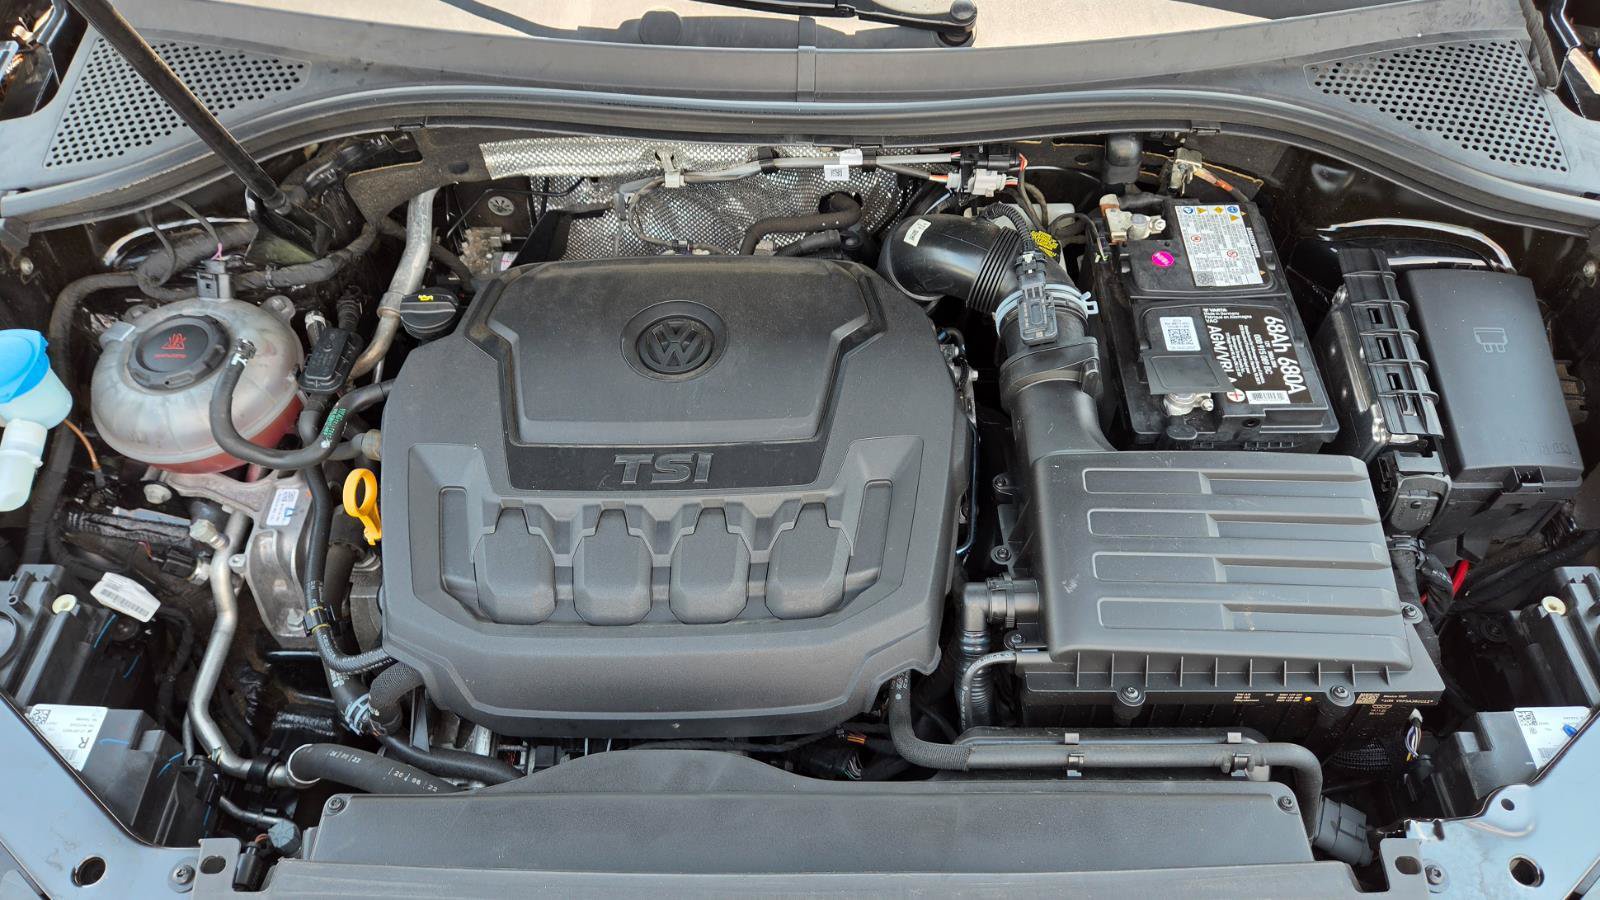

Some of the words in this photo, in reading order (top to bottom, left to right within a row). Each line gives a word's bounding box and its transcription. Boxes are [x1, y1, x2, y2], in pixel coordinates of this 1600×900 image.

[1263, 316, 1292, 353] 68Ah
[1277, 356, 1307, 394] 680A
[614, 453, 714, 485] TSI
